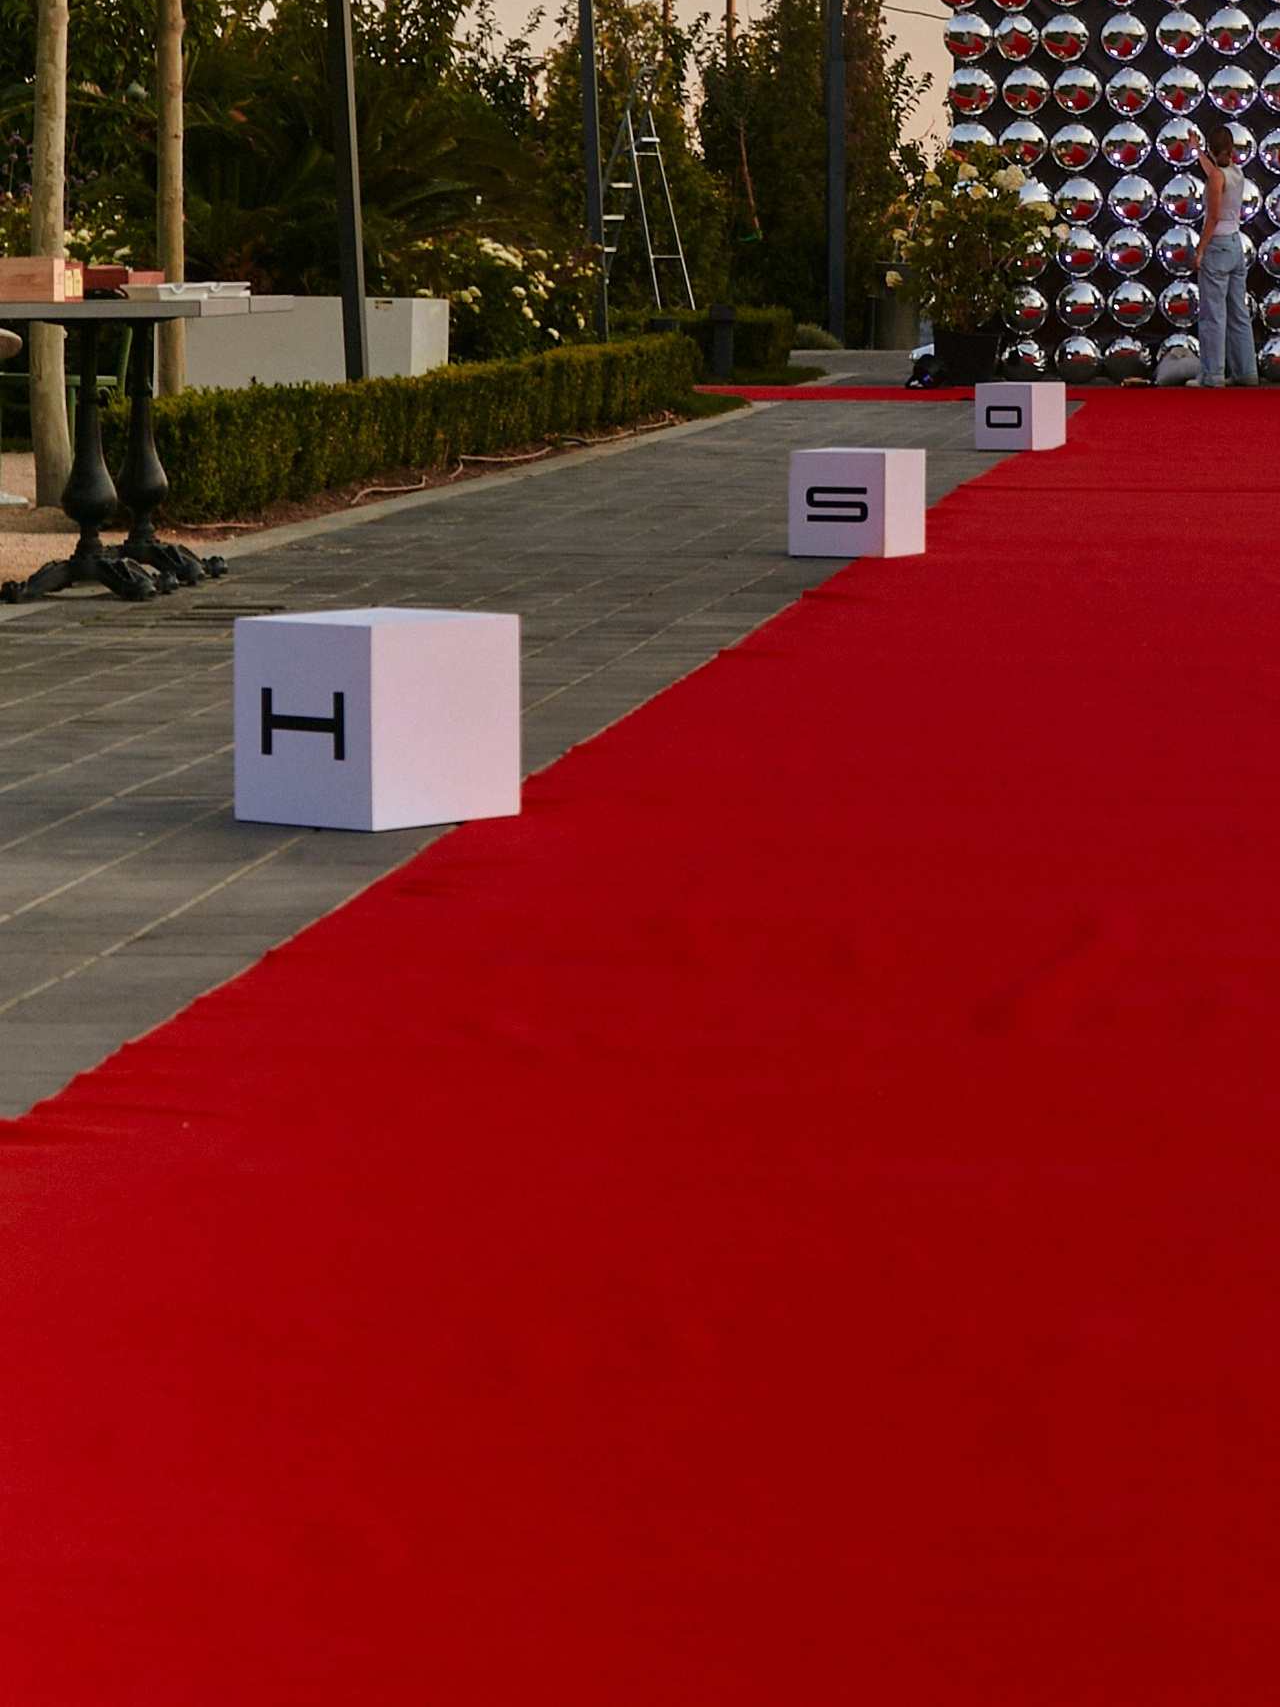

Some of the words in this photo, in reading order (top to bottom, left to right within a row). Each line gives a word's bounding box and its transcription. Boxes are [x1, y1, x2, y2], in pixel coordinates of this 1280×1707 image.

[985, 405, 1023, 429] O
[805, 486, 869, 523] S
[261, 687, 346, 761] H
